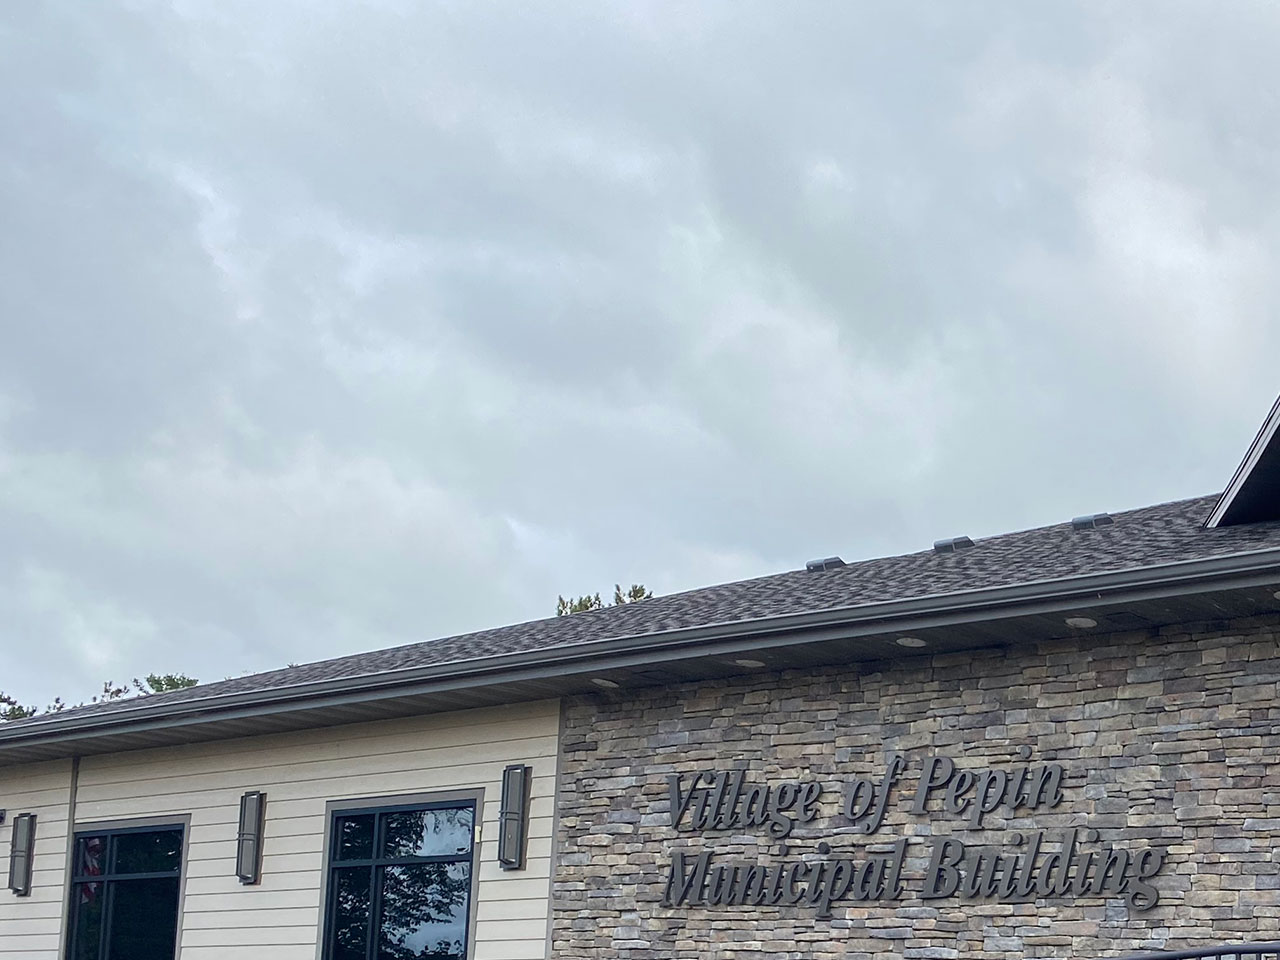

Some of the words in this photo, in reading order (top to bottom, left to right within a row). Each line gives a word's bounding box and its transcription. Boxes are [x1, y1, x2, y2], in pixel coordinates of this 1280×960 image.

[666, 768, 823, 840] Village
[844, 754, 908, 835] of
[914, 745, 1065, 831] Pepin
[659, 837, 910, 919] Municipal
[922, 828, 1168, 912] Building
